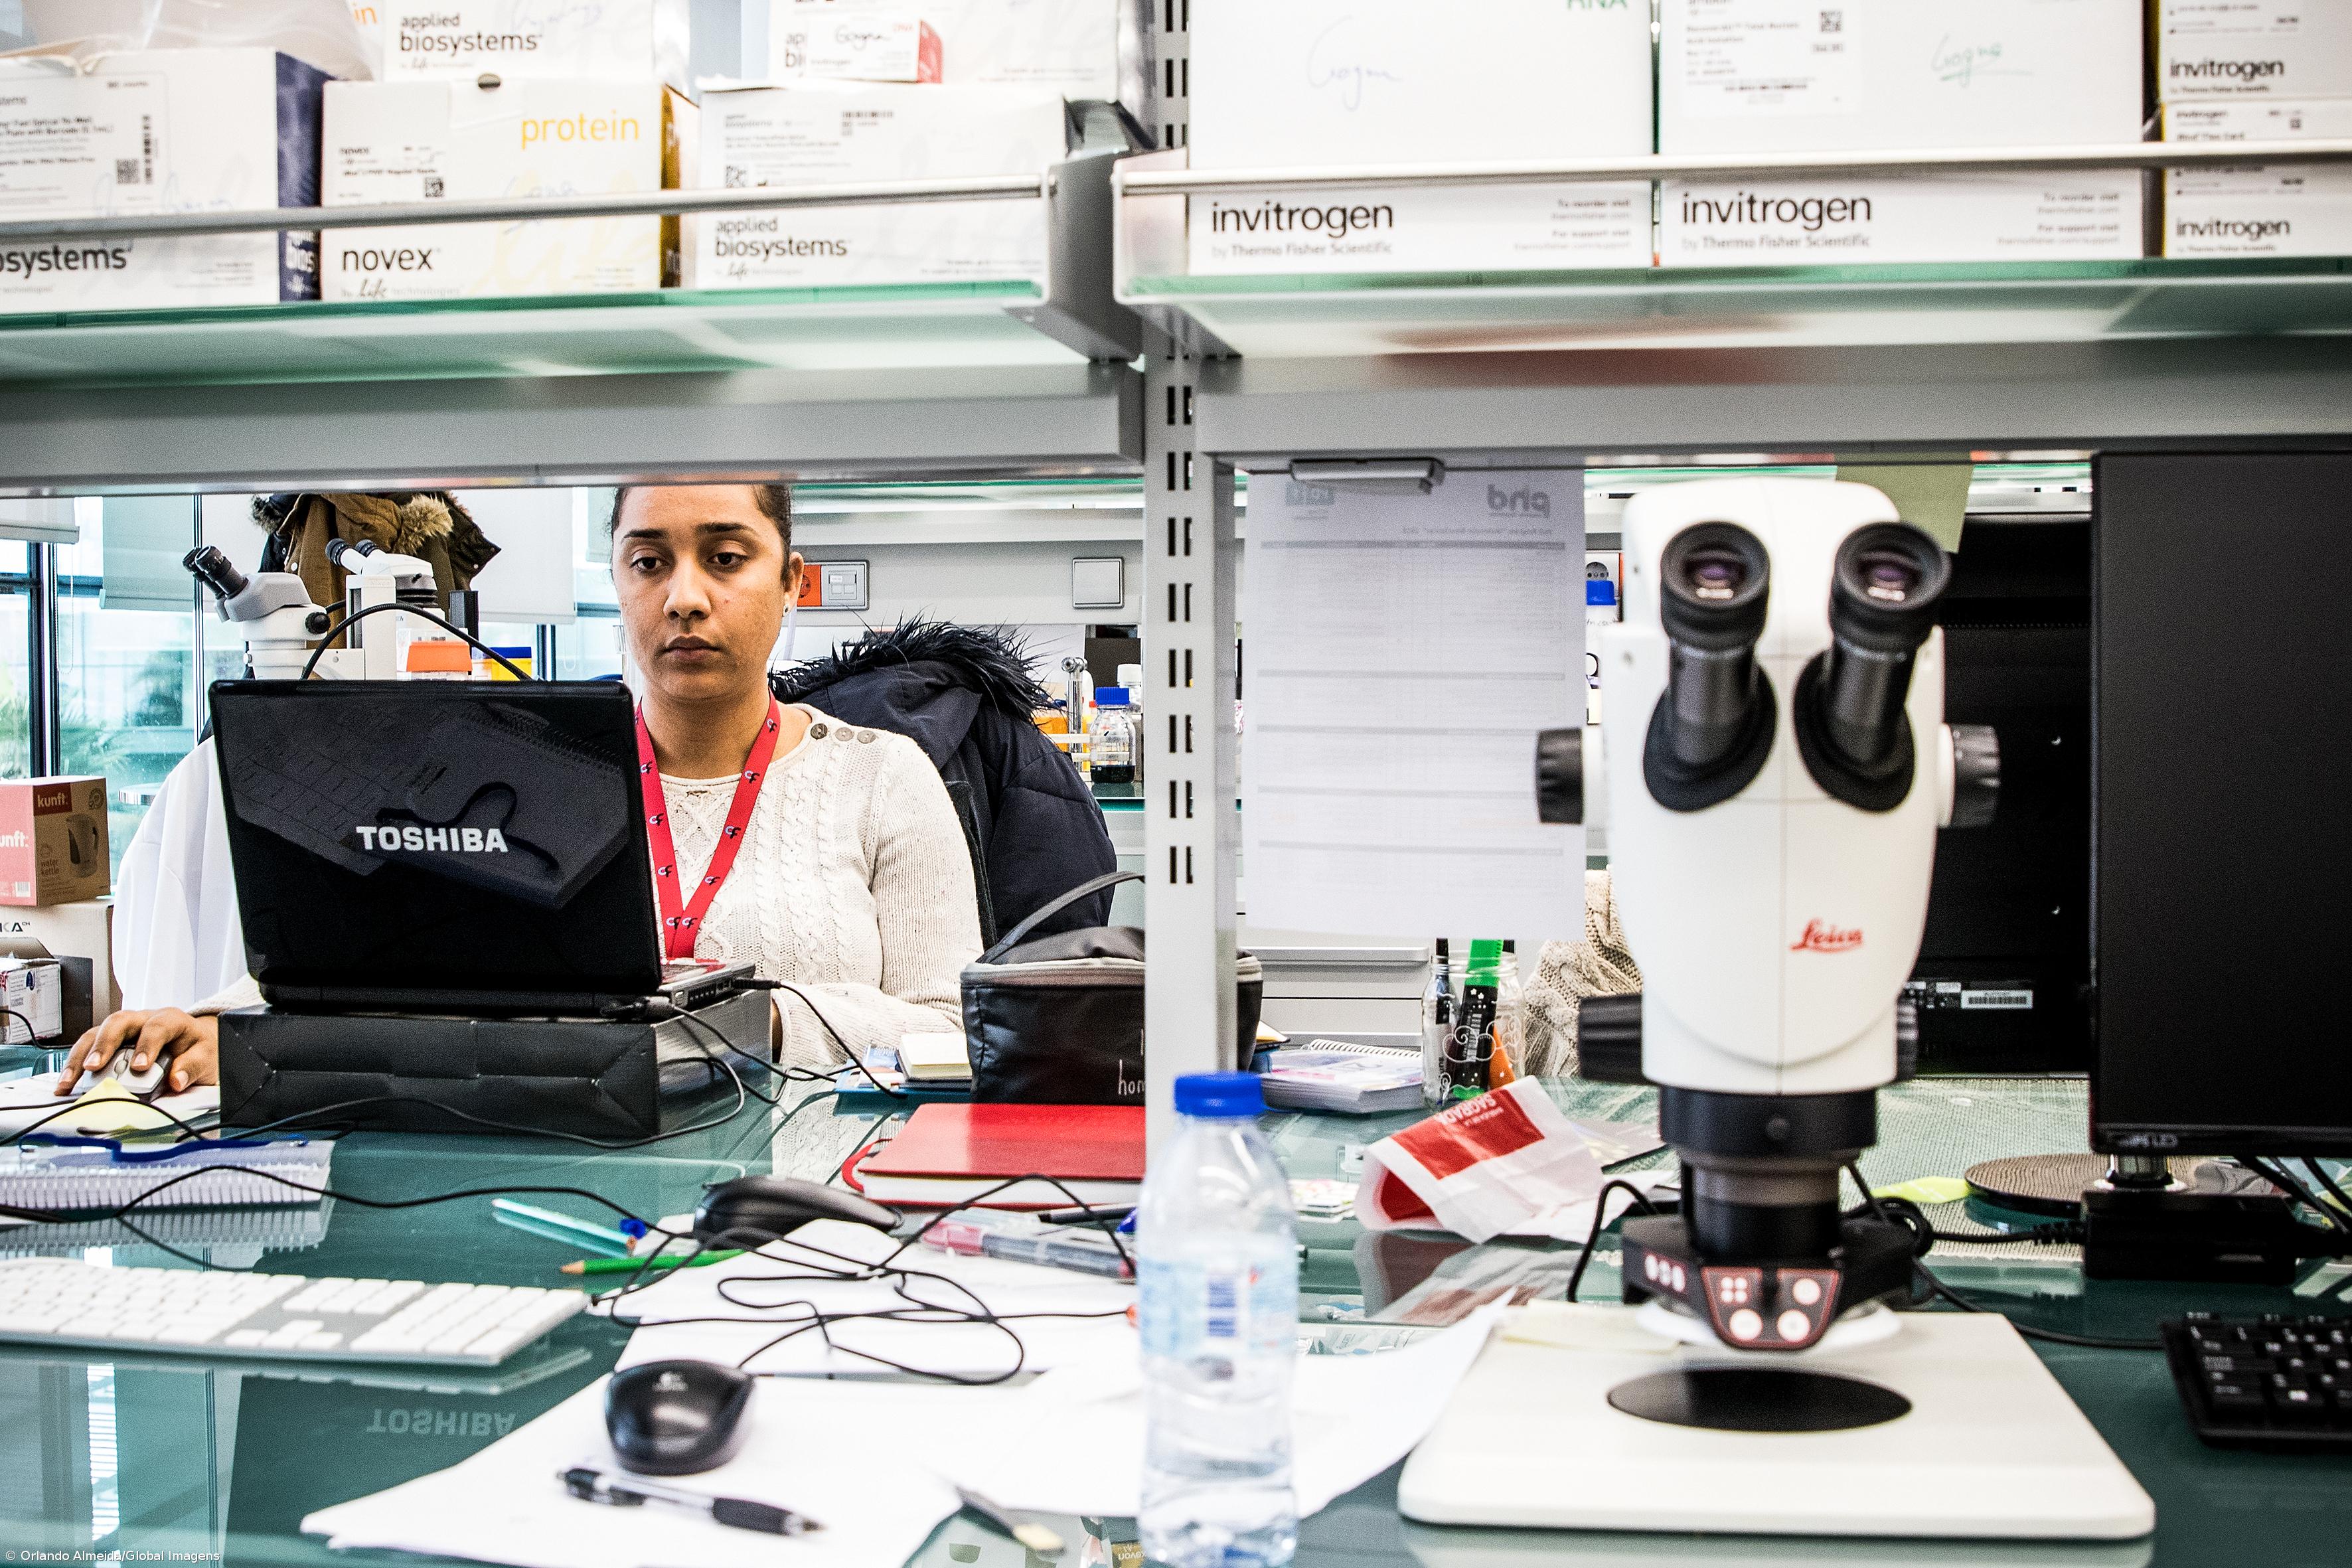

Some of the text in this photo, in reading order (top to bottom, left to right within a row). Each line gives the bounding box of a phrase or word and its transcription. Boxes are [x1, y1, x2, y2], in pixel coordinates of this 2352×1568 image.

[401, 13, 460, 29] applied
[400, 31, 538, 56] biosystems
[2169, 57, 2284, 82] invitrogen
[521, 109, 639, 150] protein
[1212, 200, 1393, 239] invitrogen
[1682, 191, 1871, 231] invitrogen
[716, 216, 779, 236] applied
[2175, 216, 2292, 241] invitrogen
[715, 235, 848, 262] biosystems
[1231, 244, 1283, 256] Thermo
[1286, 243, 1327, 256] Fisher
[1330, 241, 1392, 255] Scientific
[1703, 236, 1757, 249] Thermo
[1759, 236, 1800, 248] Fisher
[0, 244, 128, 279] systems
[343, 249, 433, 271] novex
[355, 825, 509, 853] TOSHIBA
[1790, 917, 1863, 953] Leica
